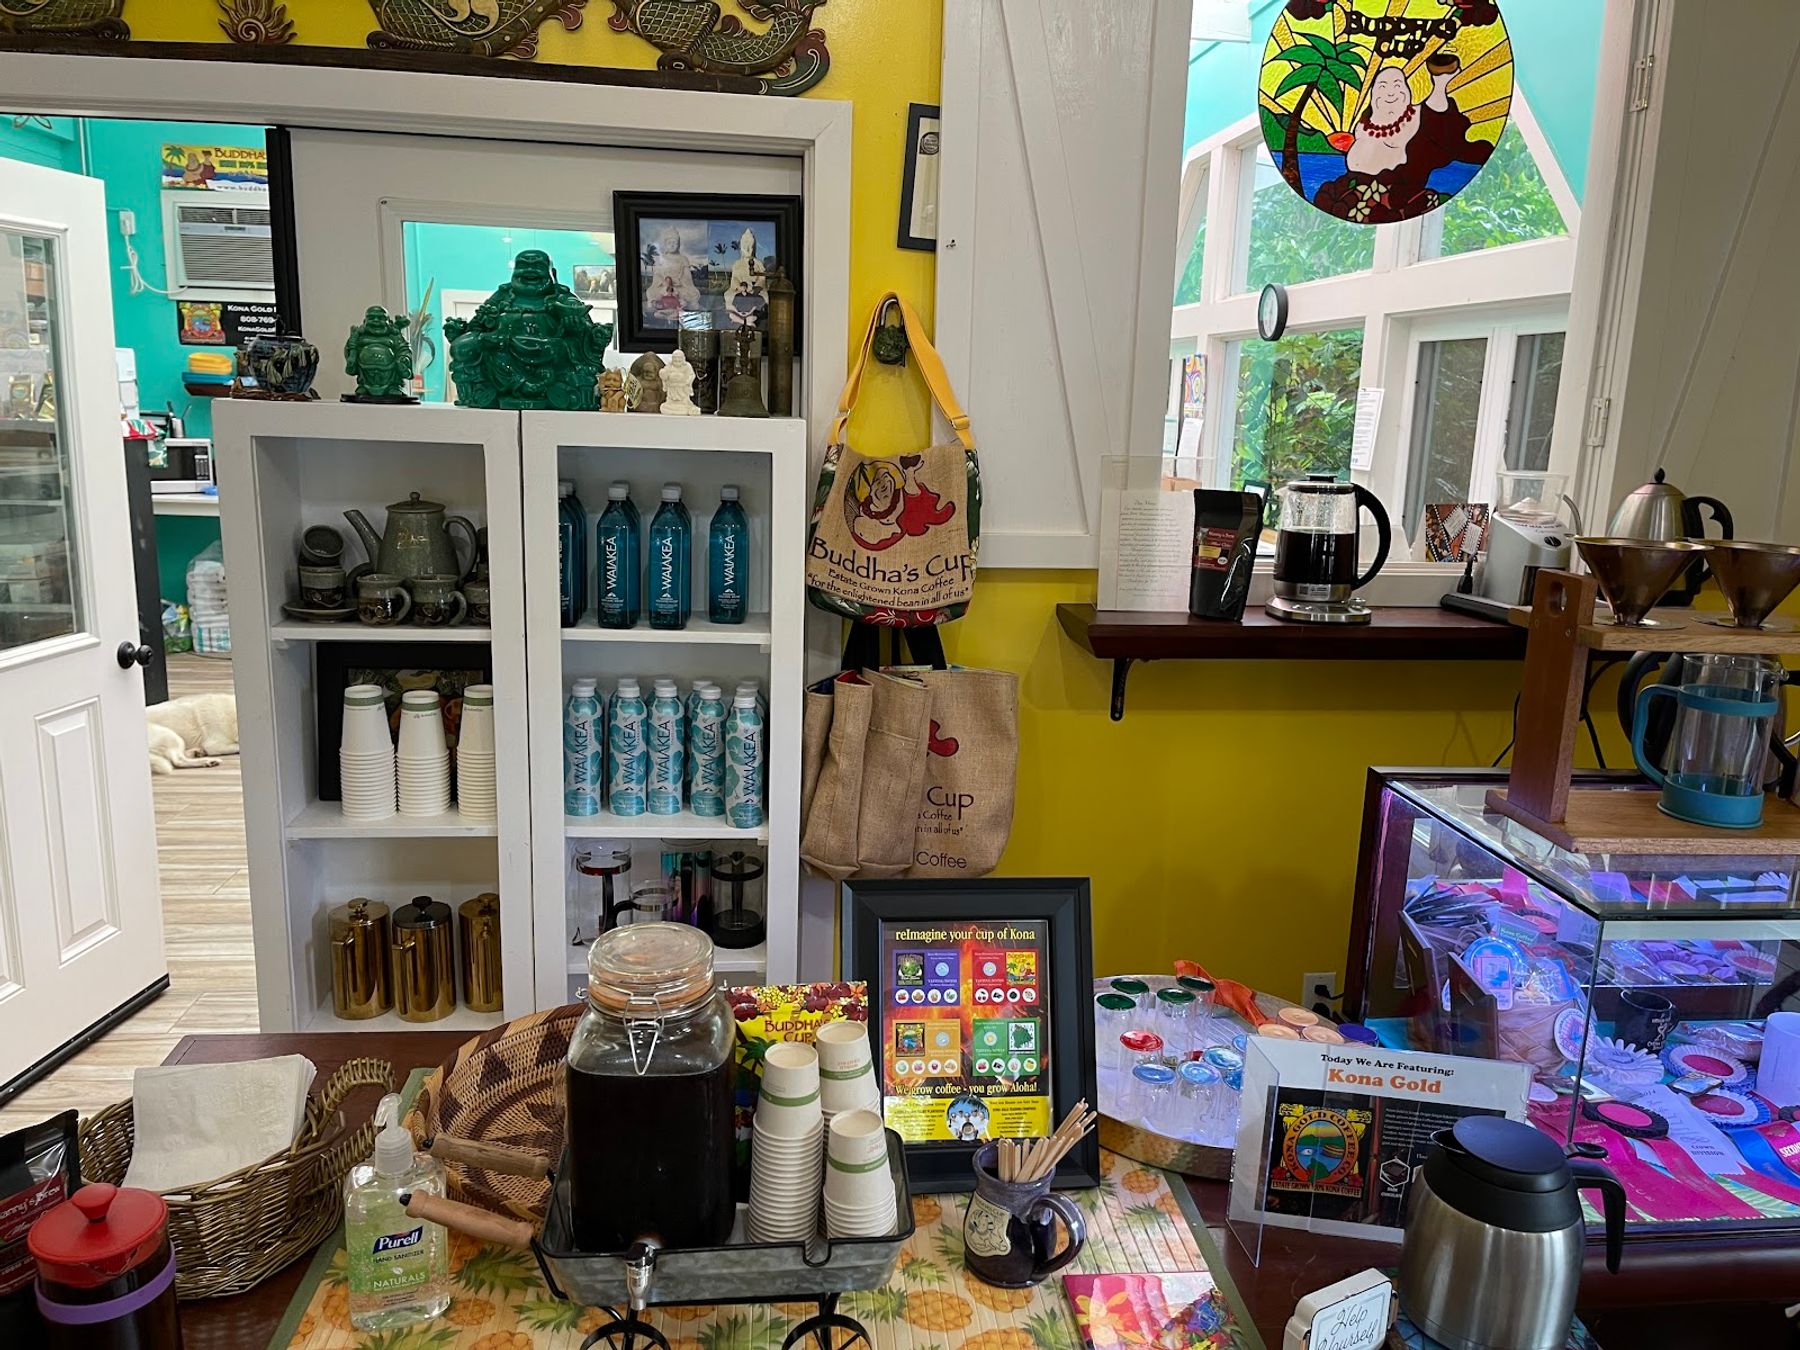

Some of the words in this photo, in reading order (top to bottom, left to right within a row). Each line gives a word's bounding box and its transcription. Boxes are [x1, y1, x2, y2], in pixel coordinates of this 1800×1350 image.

[250, 305, 273, 313] GOLD
[809, 537, 920, 583] Buddha's
[925, 554, 973, 582] Cup
[828, 568, 858, 588] Estate
[859, 581, 891, 595] Grown
[893, 587, 920, 596] Kona
[921, 576, 954, 593] Coffee
[826, 582, 841, 593] the
[842, 588, 895, 607] enlightened
[896, 599, 920, 607] bean
[921, 597, 930, 605] in
[930, 590, 941, 603] all
[942, 588, 953, 600] of
[927, 786, 974, 820] Cup
[923, 809, 952, 821] Coffee
[916, 851, 967, 869] Coffee
[895, 928, 947, 943] reImagine
[950, 930, 973, 943] your
[975, 930, 995, 943] cup
[997, 927, 1008, 940] of
[1010, 928, 1036, 940] Kona
[783, 1031, 814, 1043] CUP
[1320, 1054, 1353, 1066] Today
[1355, 1057, 1372, 1067] We
[1374, 1060, 1395, 1069] Are
[1396, 1062, 1455, 1077] Featuring:
[895, 1084, 909, 1095] We
[910, 1085, 933, 1097] grow
[934, 1082, 962, 1094] coffee
[969, 1084, 985, 1096] you
[987, 1083, 1008, 1096] grow
[1010, 1082, 1037, 1093] Aloha!
[1328, 1068, 1383, 1088] Kona
[1390, 1075, 1441, 1094] Gold
[1292, 1111, 1327, 1133] GOLD
[1329, 1111, 1356, 1159] COFFEE
[1286, 1135, 1299, 1171] KONA
[0, 1199, 35, 1219] anny's
[379, 1231, 419, 1250] Purell
[374, 1271, 426, 1288] NATURALS
[1331, 1304, 1368, 1336] Help
